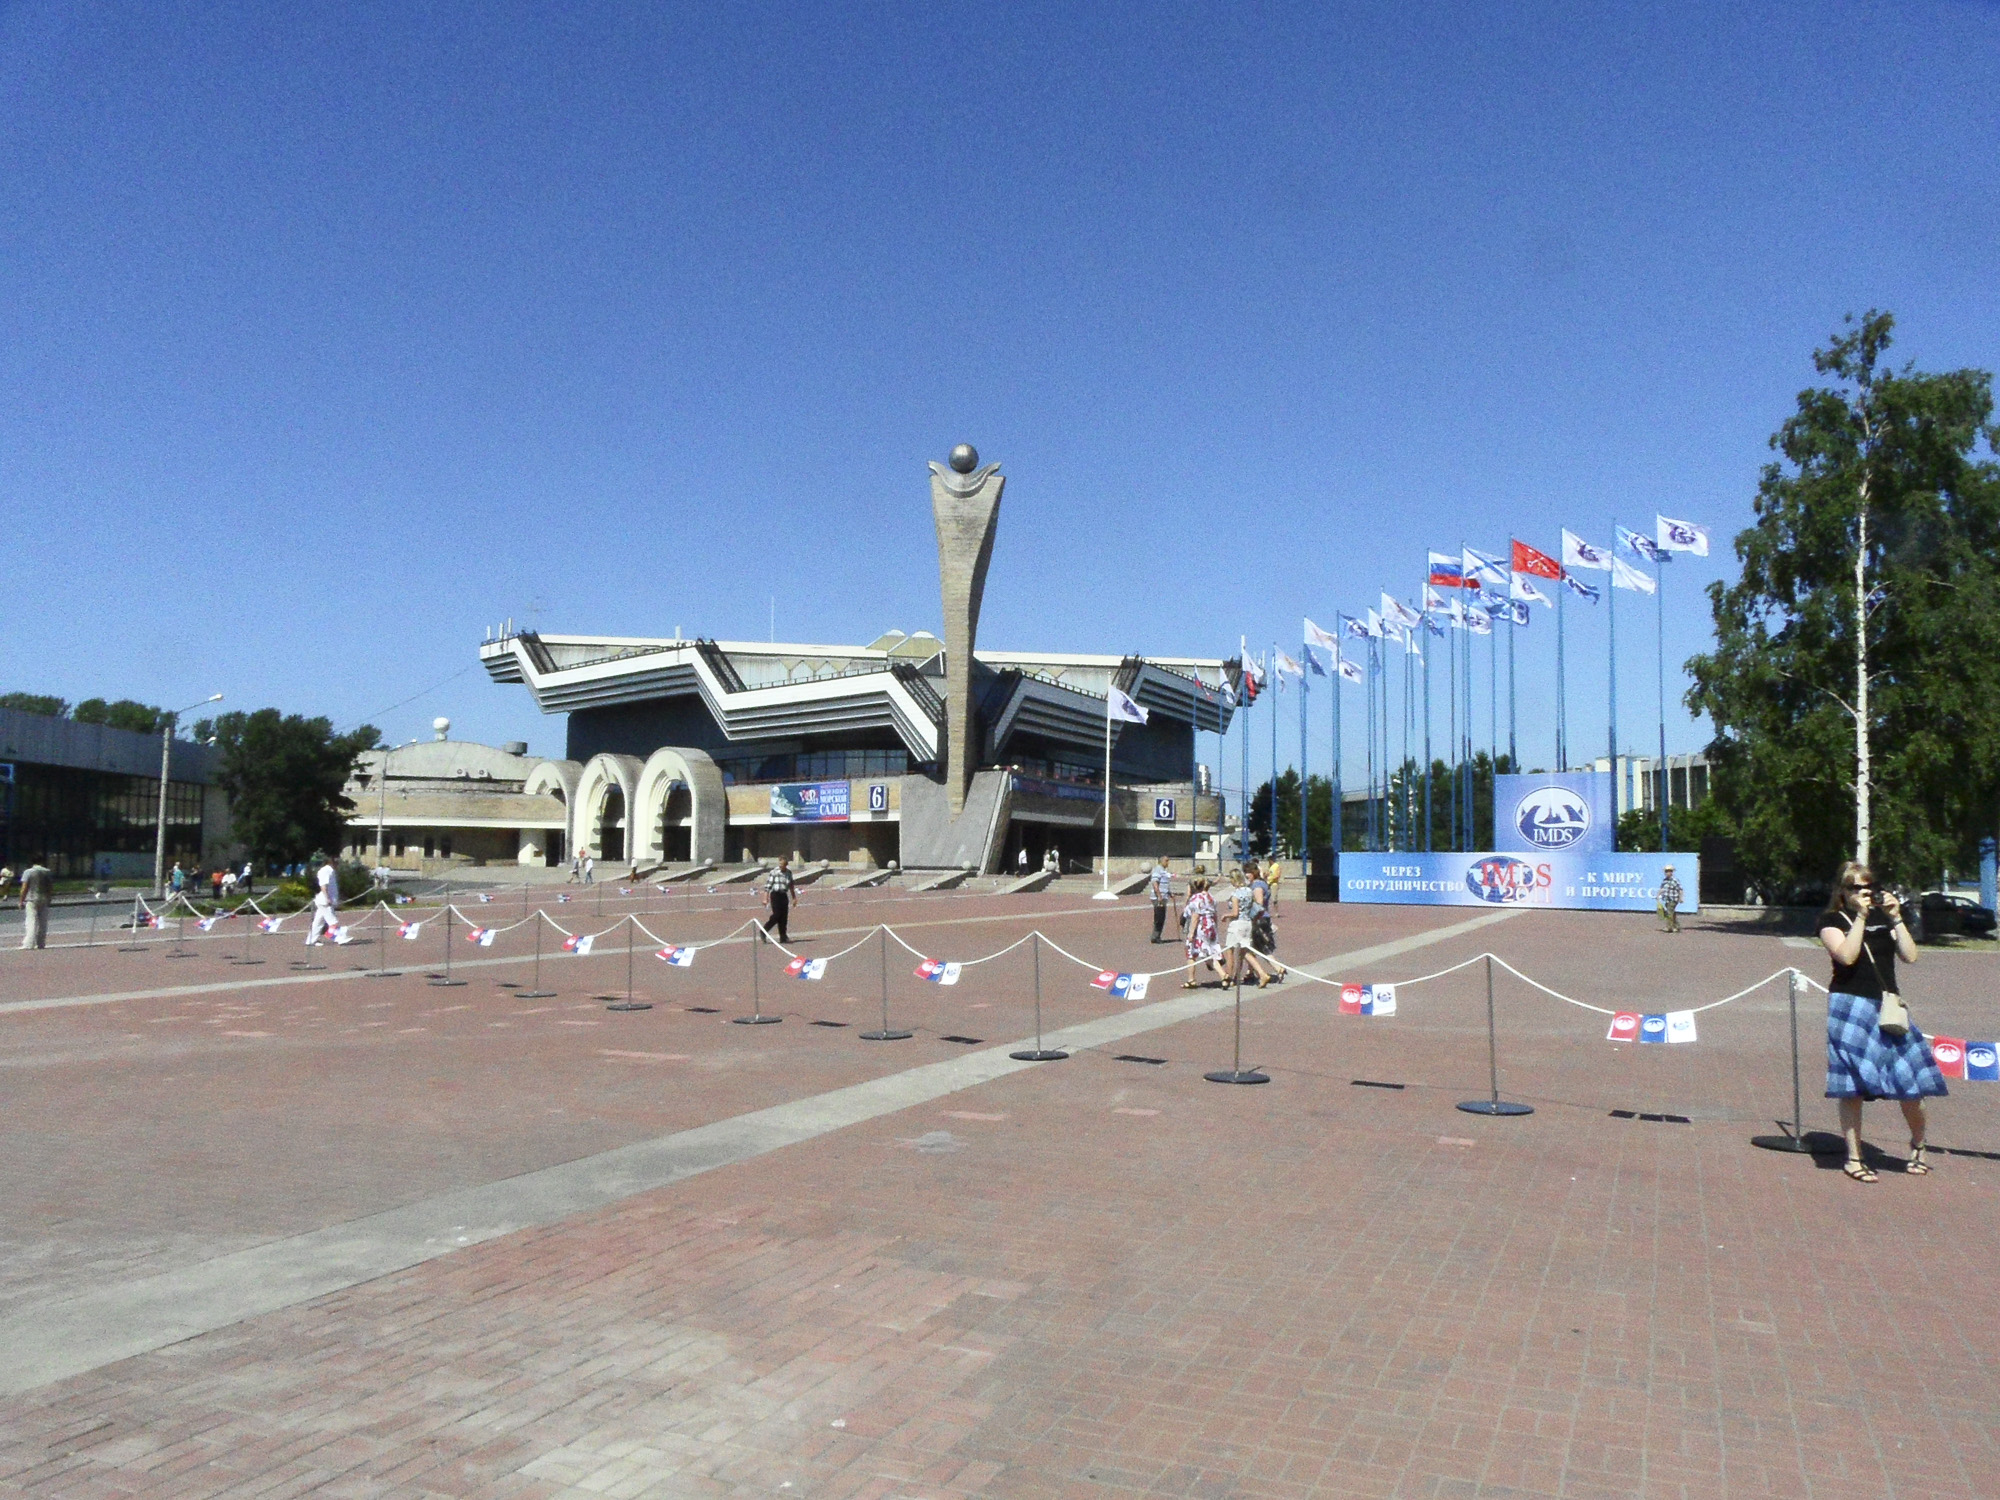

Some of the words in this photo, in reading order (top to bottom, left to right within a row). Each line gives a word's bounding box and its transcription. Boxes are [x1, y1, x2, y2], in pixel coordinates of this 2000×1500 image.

[872, 787, 882, 807] 6
[820, 803, 847, 815] САЛОН
[1158, 800, 1169, 817] 6
[1533, 828, 1573, 842] IMDS
[1382, 866, 1421, 877] ЧЕРЕЗ
[1481, 861, 1552, 888] IMDS
[1603, 872, 1643, 883] МИРУ
[1347, 880, 1464, 892] СОТРУДНИЧЕСТВО
[1566, 886, 1575, 897] И
[1582, 886, 1660, 898] ПРОГРЕСС
[1502, 886, 1552, 904] 2011
